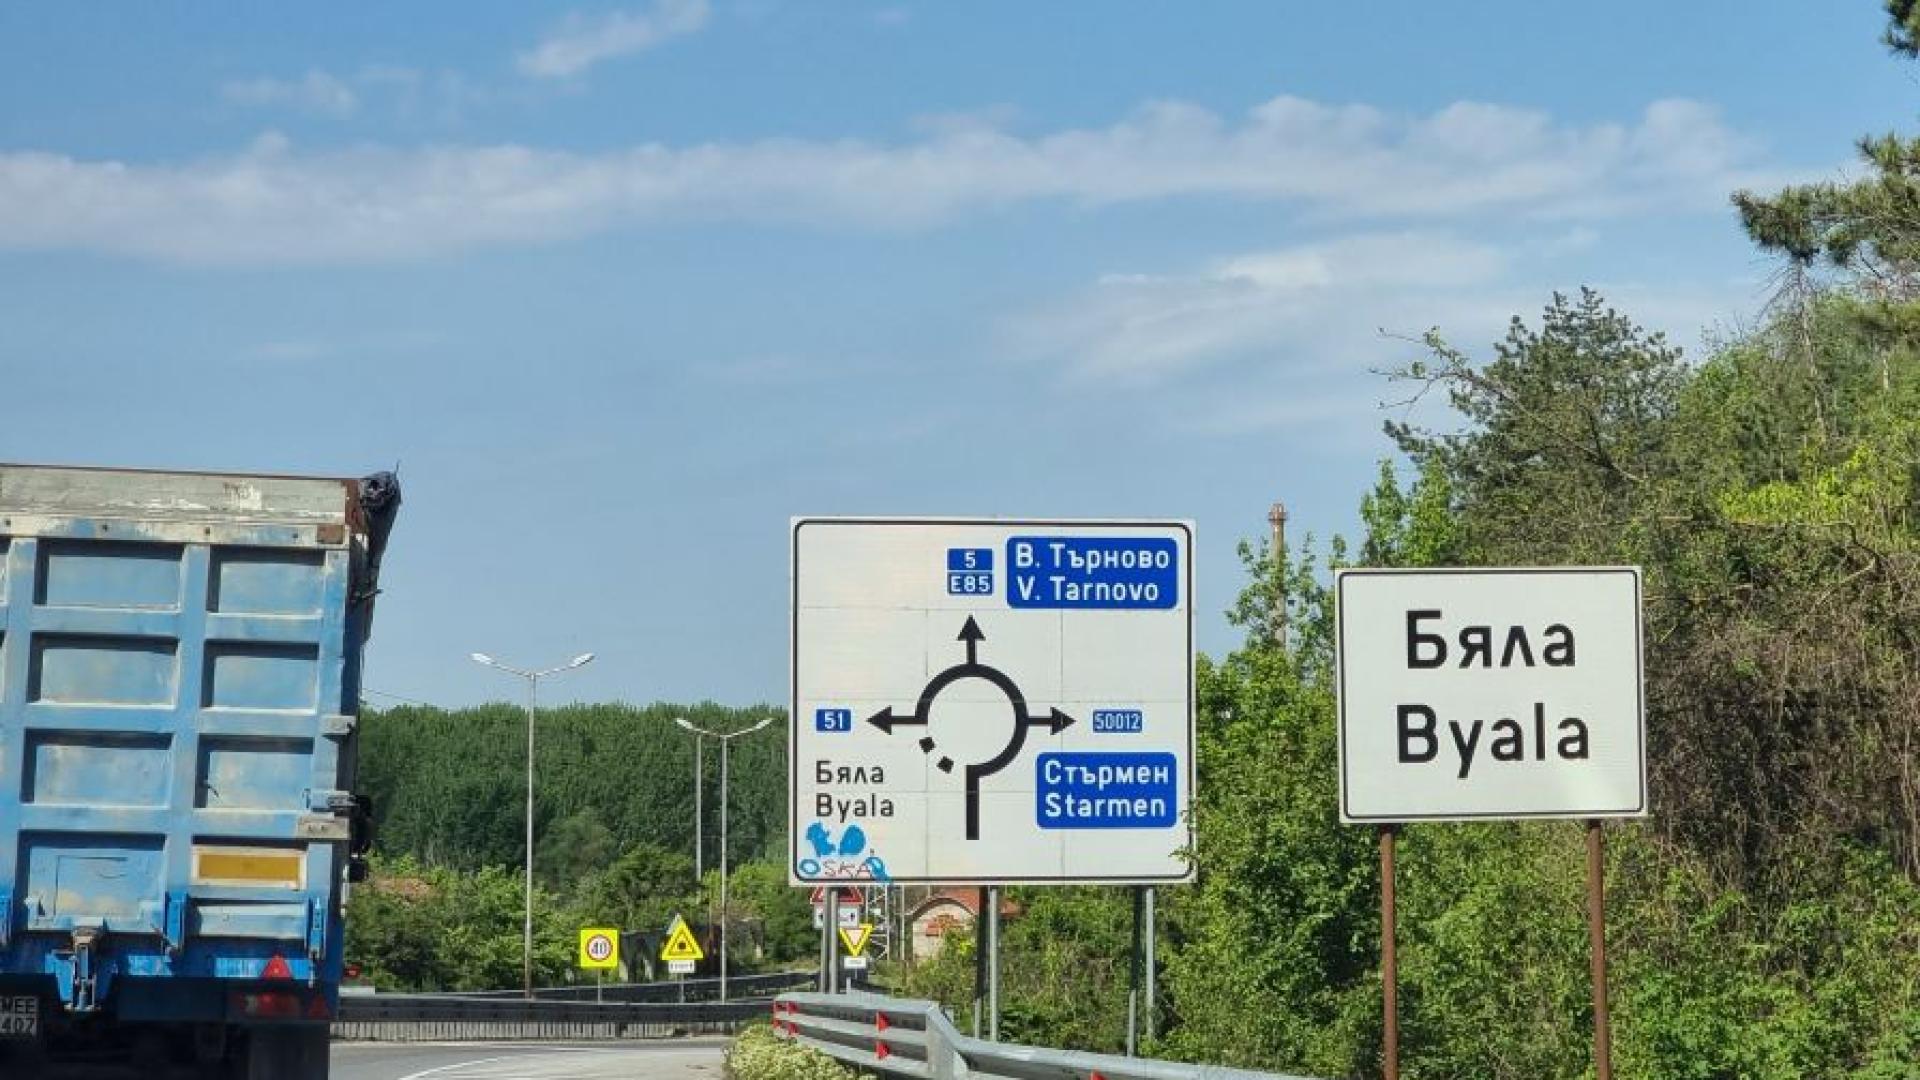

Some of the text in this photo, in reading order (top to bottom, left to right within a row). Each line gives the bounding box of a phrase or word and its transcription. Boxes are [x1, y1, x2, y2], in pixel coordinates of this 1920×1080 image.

[963, 551, 977, 569] 5
[1015, 542, 1169, 574] В. Търново
[950, 575, 991, 594] E85
[1016, 576, 1159, 601] V. Tarnovo
[1405, 608, 1576, 669] Бяла
[824, 711, 844, 730] 51
[1094, 713, 1141, 730] 50012
[1396, 702, 1590, 778] Byala
[815, 760, 884, 784] Бяла
[1045, 759, 1169, 791] Стърмен
[815, 792, 895, 823] Byala
[1045, 792, 1167, 818] Starmen
[591, 941, 607, 955] 40
